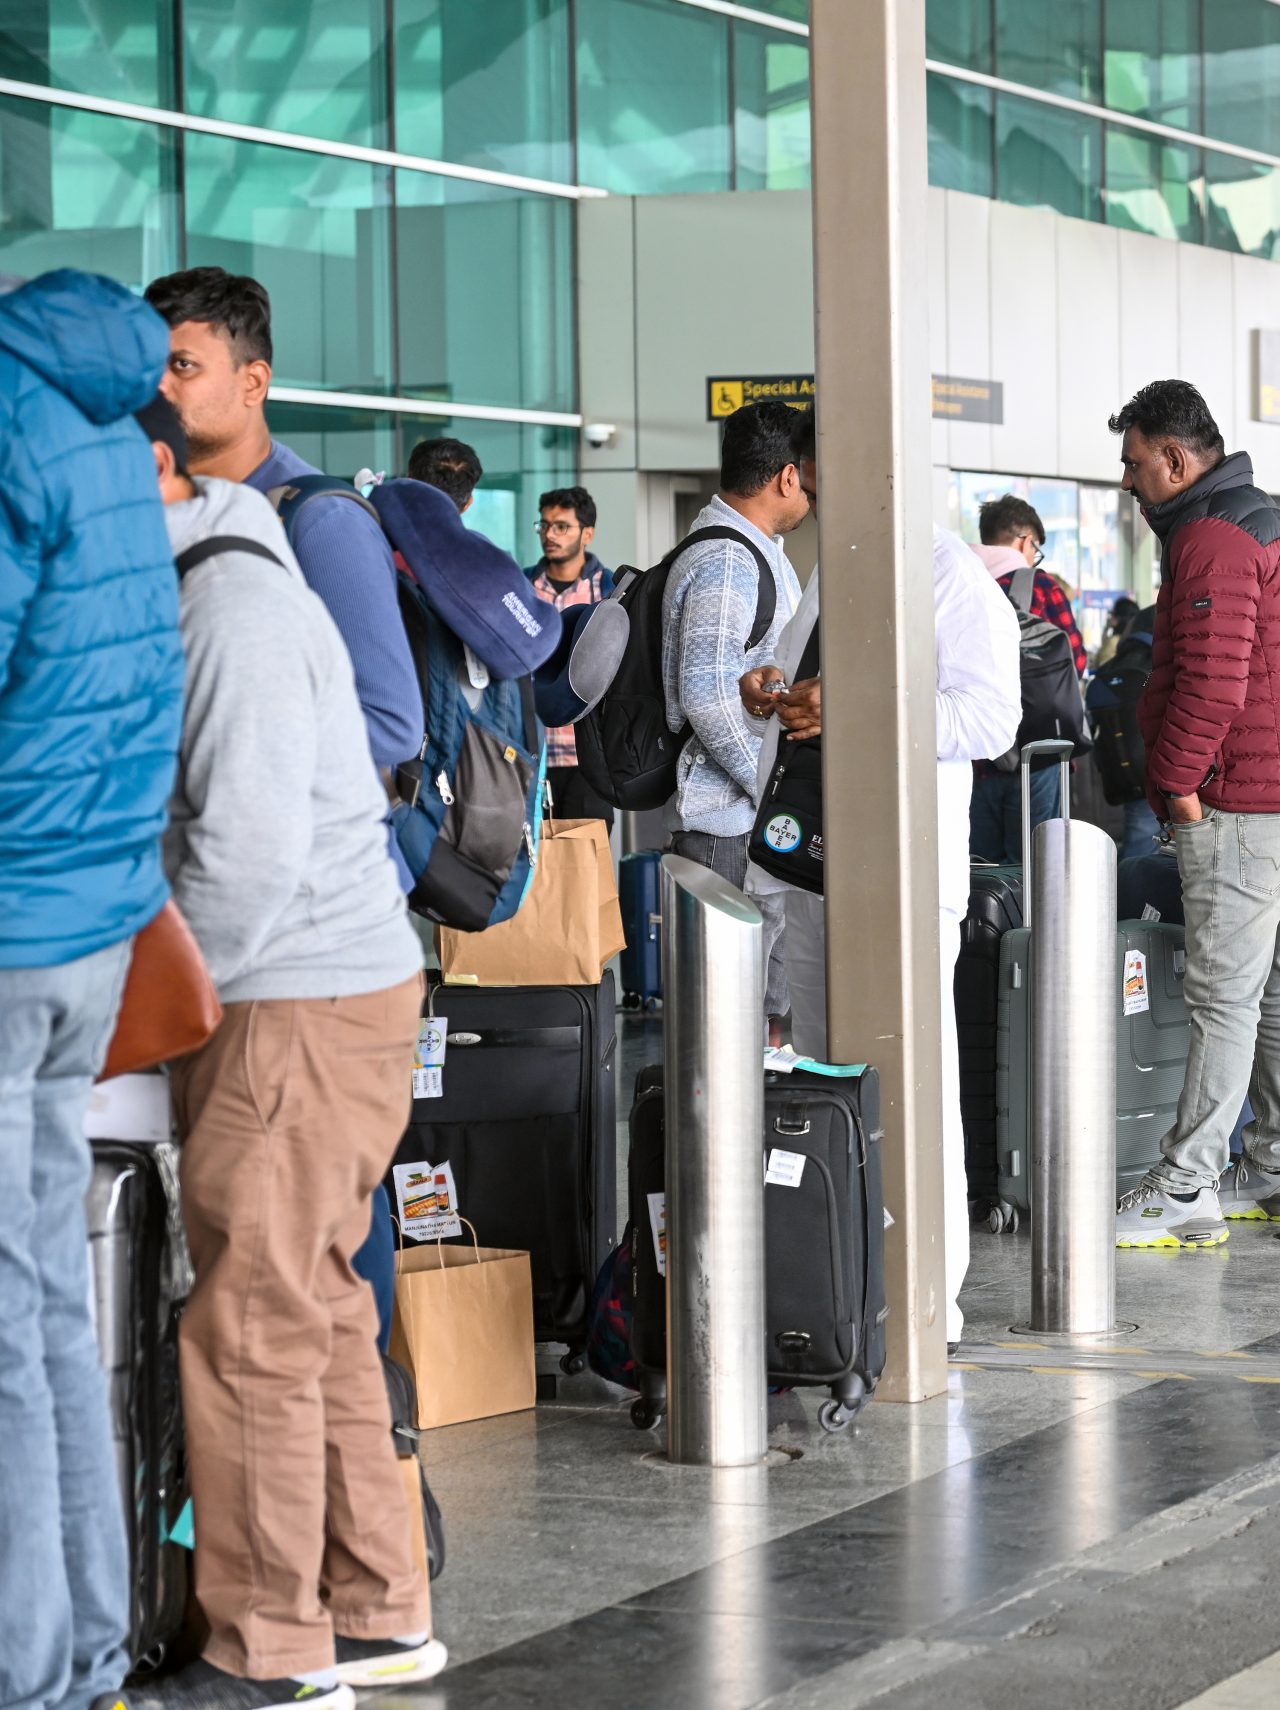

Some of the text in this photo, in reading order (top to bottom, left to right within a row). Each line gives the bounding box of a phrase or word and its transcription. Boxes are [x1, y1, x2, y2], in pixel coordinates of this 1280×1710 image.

[743, 380, 798, 399] Special
[501, 597, 538, 637] TOURISTER
[503, 591, 543, 633] AMERICAN
[769, 824, 797, 842] BAYER
[774, 818, 791, 848] BAYER
